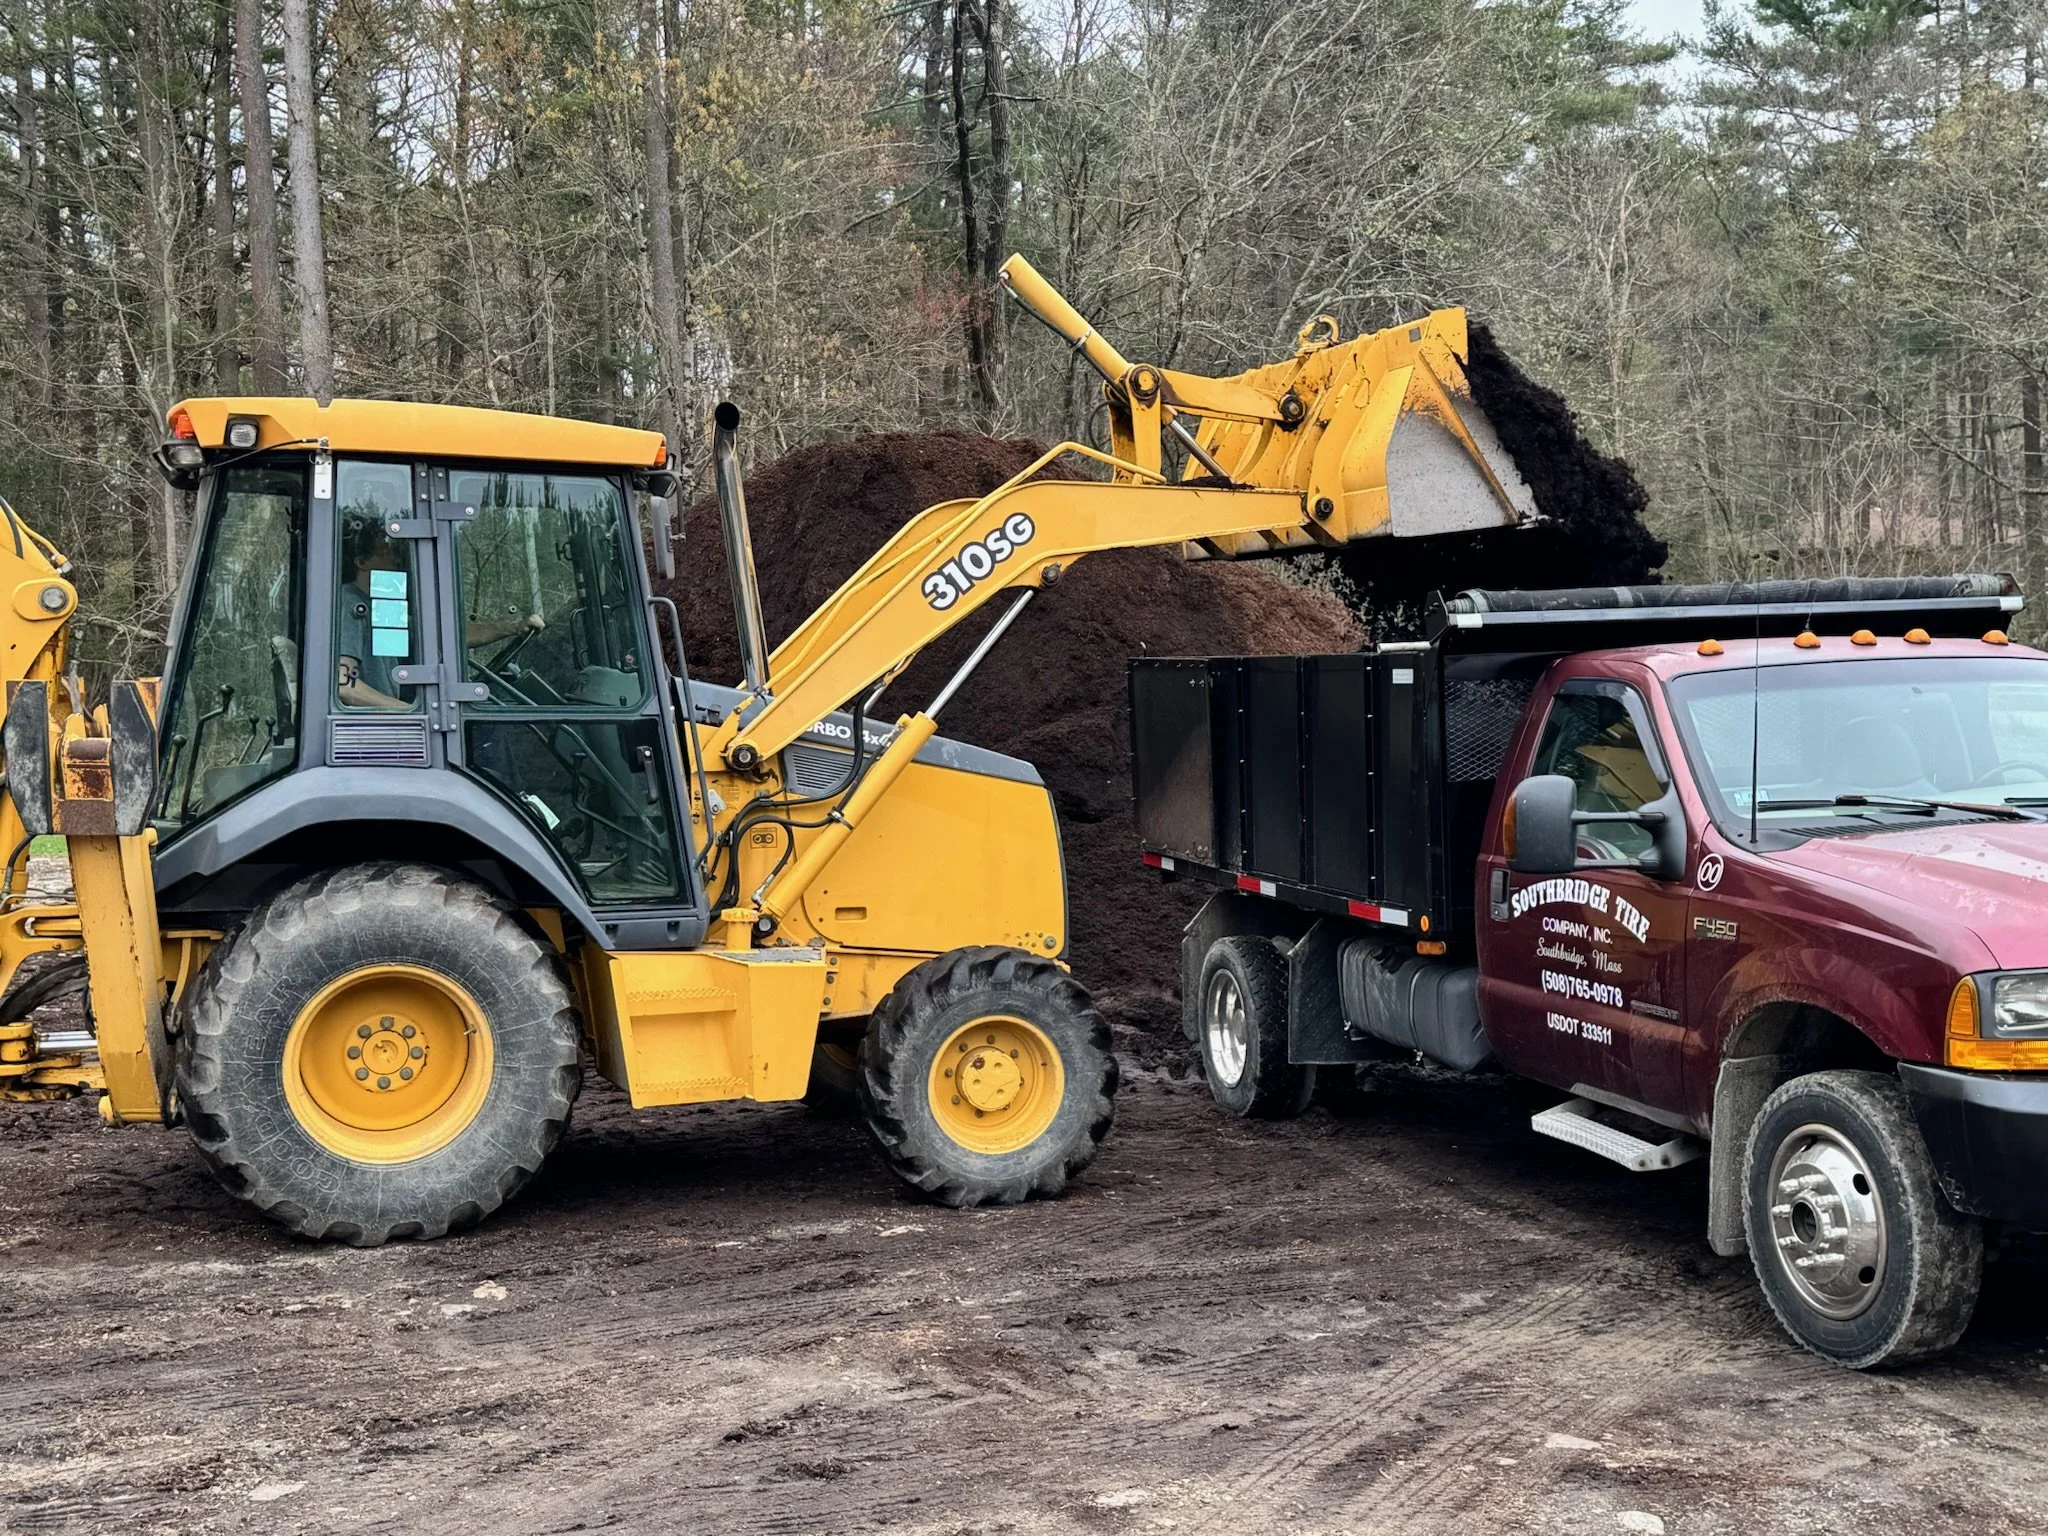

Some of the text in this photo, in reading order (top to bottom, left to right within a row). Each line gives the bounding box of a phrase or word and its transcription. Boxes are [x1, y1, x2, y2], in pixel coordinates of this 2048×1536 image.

[921, 513, 1035, 610] 310SG
[806, 721, 851, 739] RBO
[1512, 879, 1650, 944] SOUTHBRIDGE TIRE
[1542, 917, 1613, 944] COMPANY, INC.
[1536, 937, 1623, 973] Southbridge, Mass
[1541, 969, 1624, 1008] (508)765-0978
[1547, 1011, 1612, 1045] USDOT 333511
